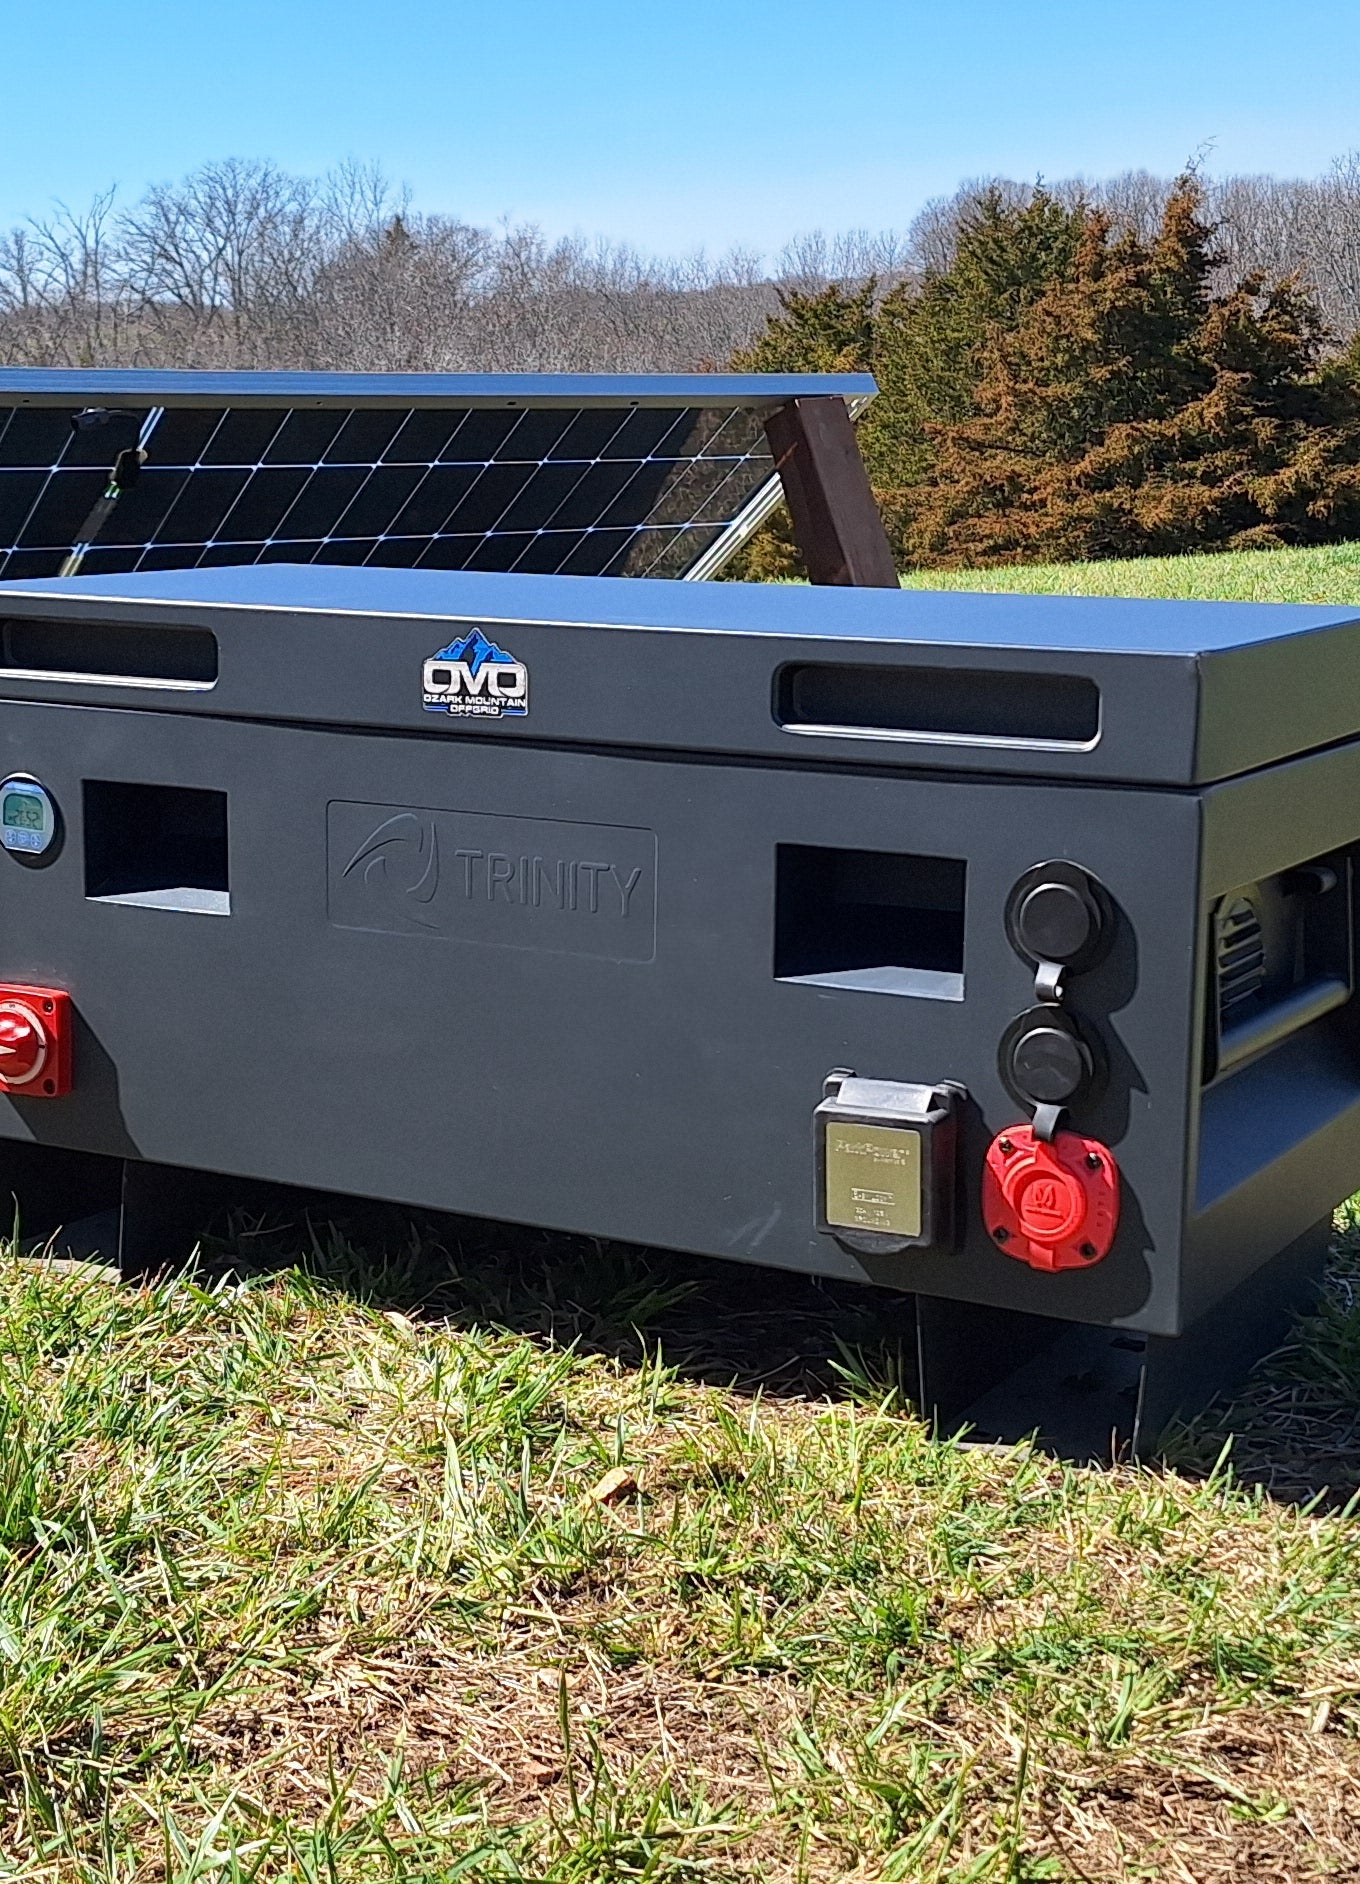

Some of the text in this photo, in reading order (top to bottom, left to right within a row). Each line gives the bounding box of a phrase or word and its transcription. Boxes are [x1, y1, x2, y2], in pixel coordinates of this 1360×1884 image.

[424, 694, 526, 707] OZARK MOUNTAIN
[450, 704, 499, 714] OFFGRID
[455, 849, 642, 917] TRINITY
